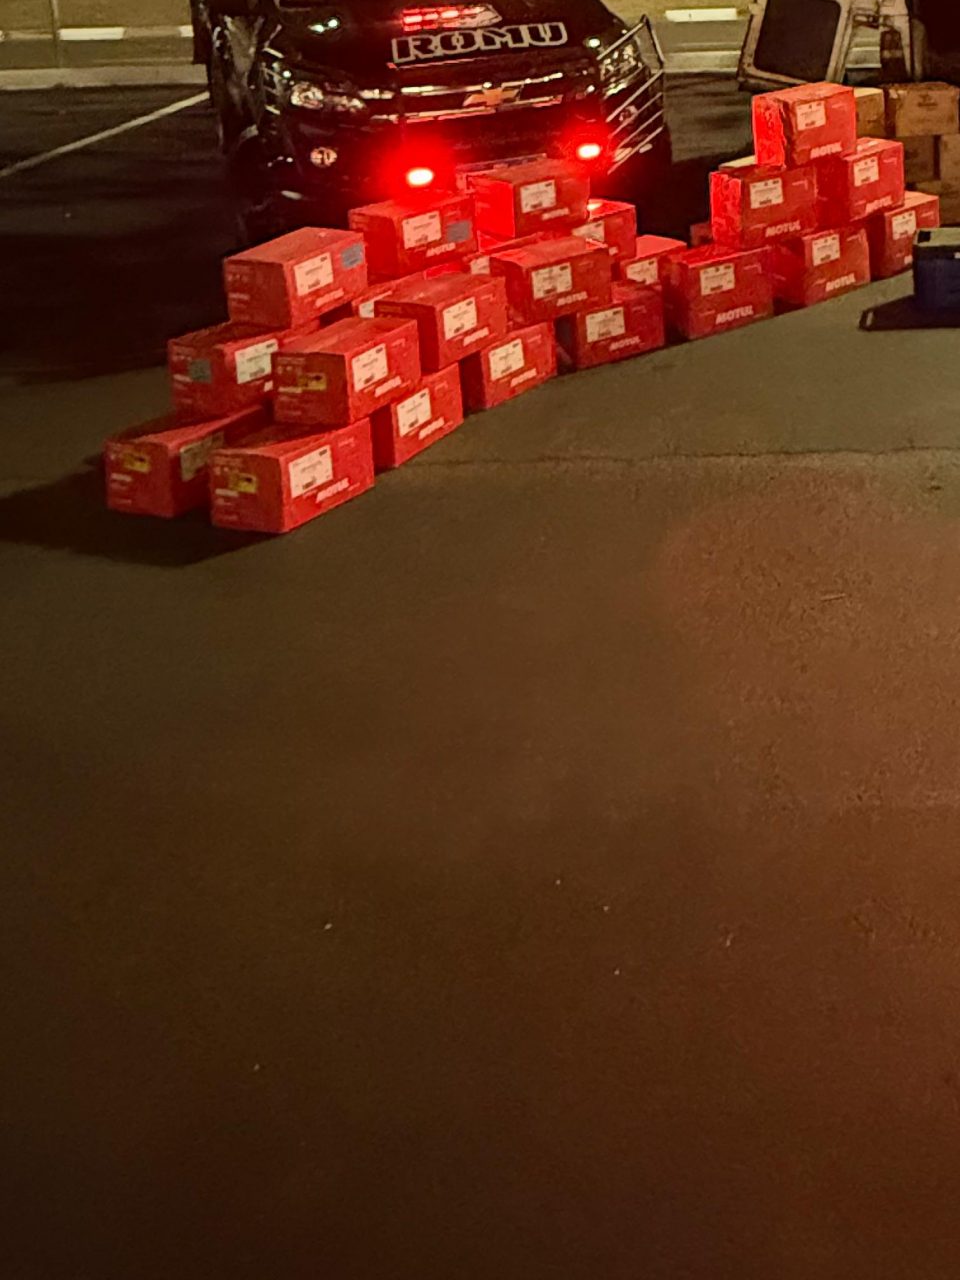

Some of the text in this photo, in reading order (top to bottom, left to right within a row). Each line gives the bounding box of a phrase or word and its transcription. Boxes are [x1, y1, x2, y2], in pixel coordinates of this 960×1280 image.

[391, 21, 569, 64] ROMU
[765, 220, 801, 238] MOTUL
[715, 305, 754, 325] MOTUL
